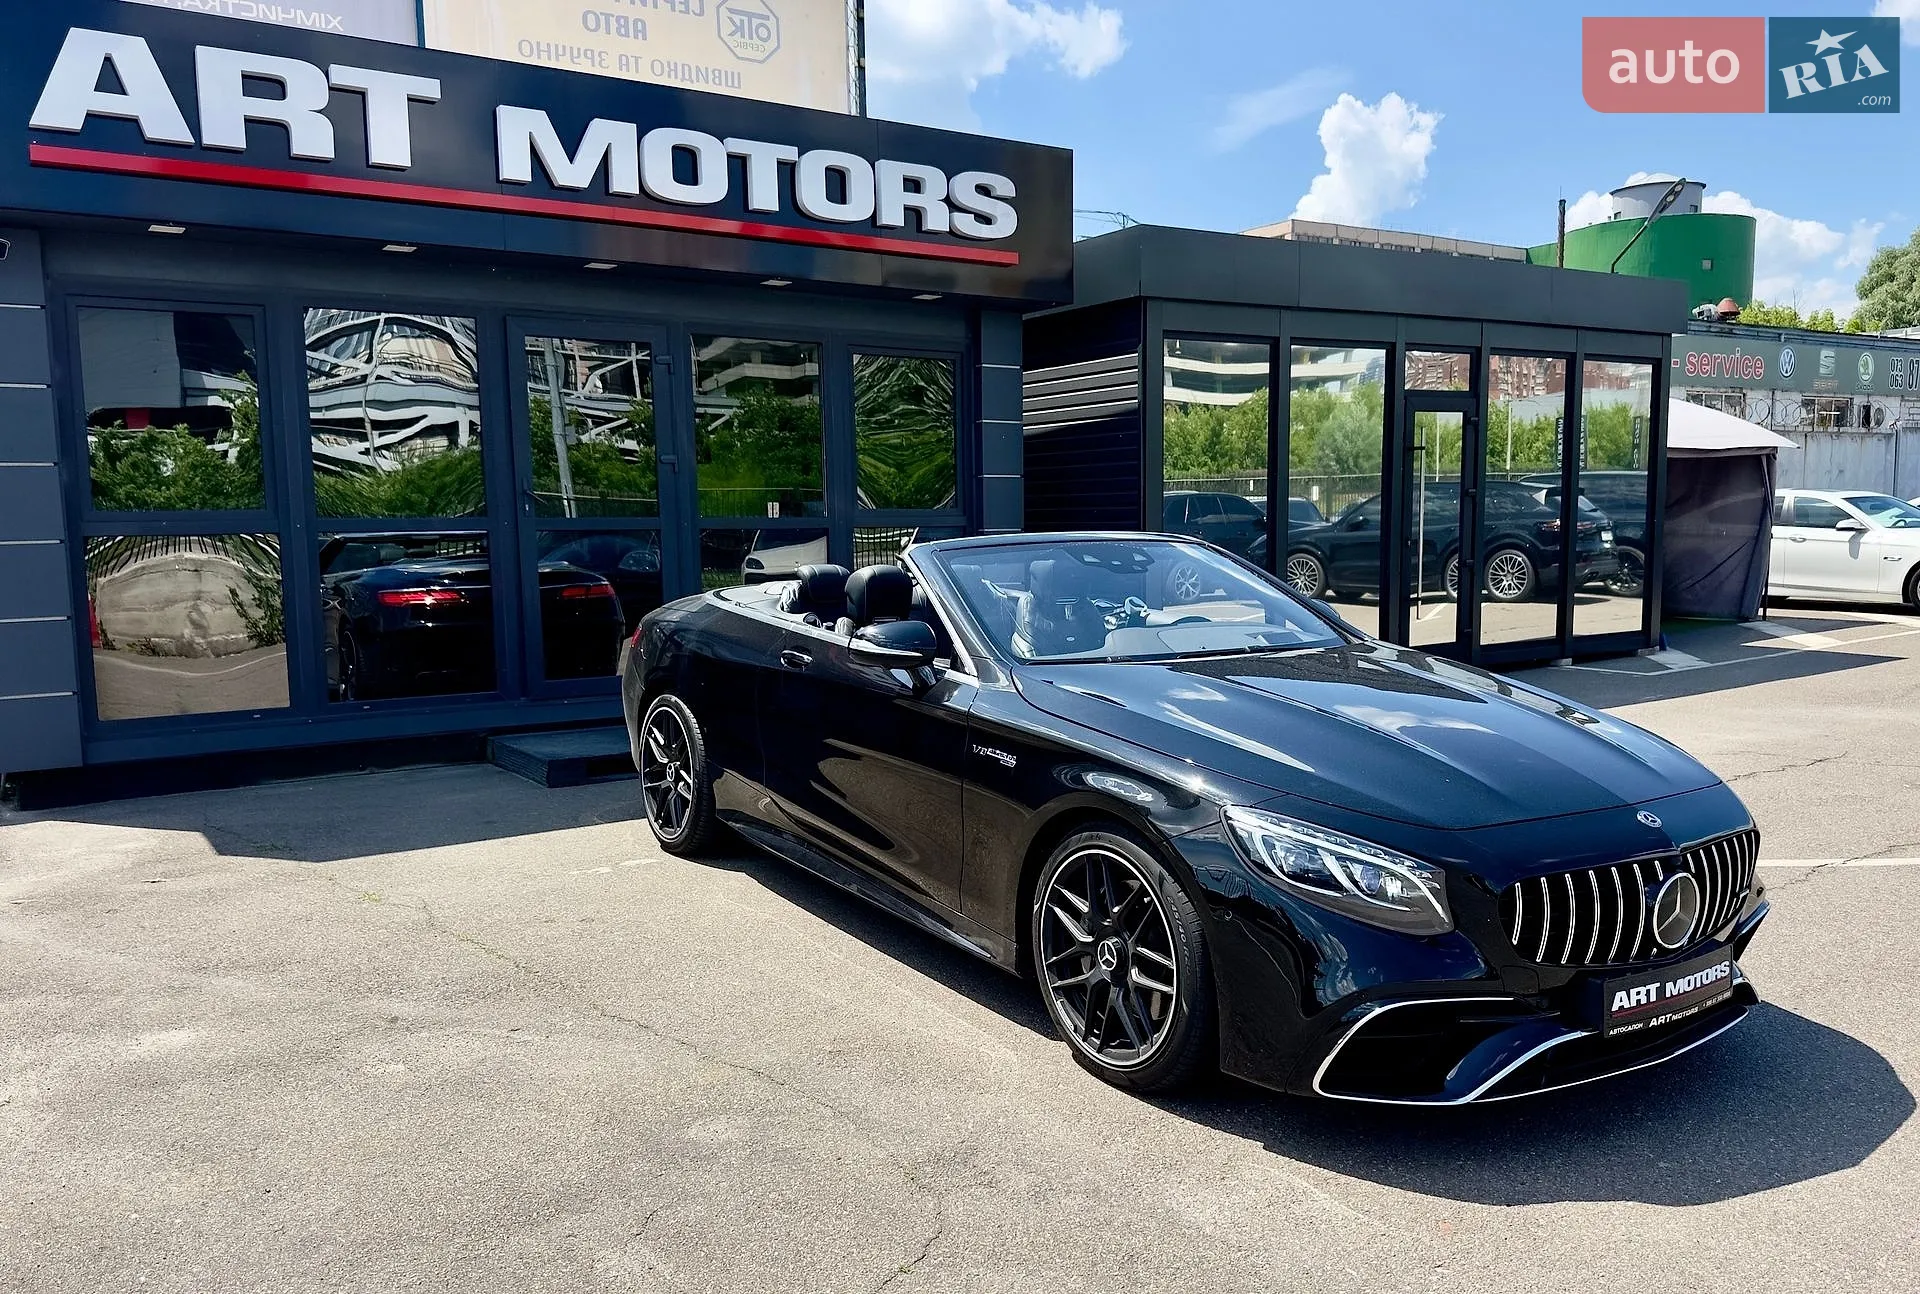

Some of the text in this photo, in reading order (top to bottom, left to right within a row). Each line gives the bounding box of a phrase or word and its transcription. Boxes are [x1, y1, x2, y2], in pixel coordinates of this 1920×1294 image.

[29, 27, 1019, 241] ART MOTORS
[1684, 348, 1765, 380] service
[1889, 357, 1903, 373] 073
[1889, 373, 1903, 389] 063
[1611, 960, 1730, 1012] ART MOTORS
